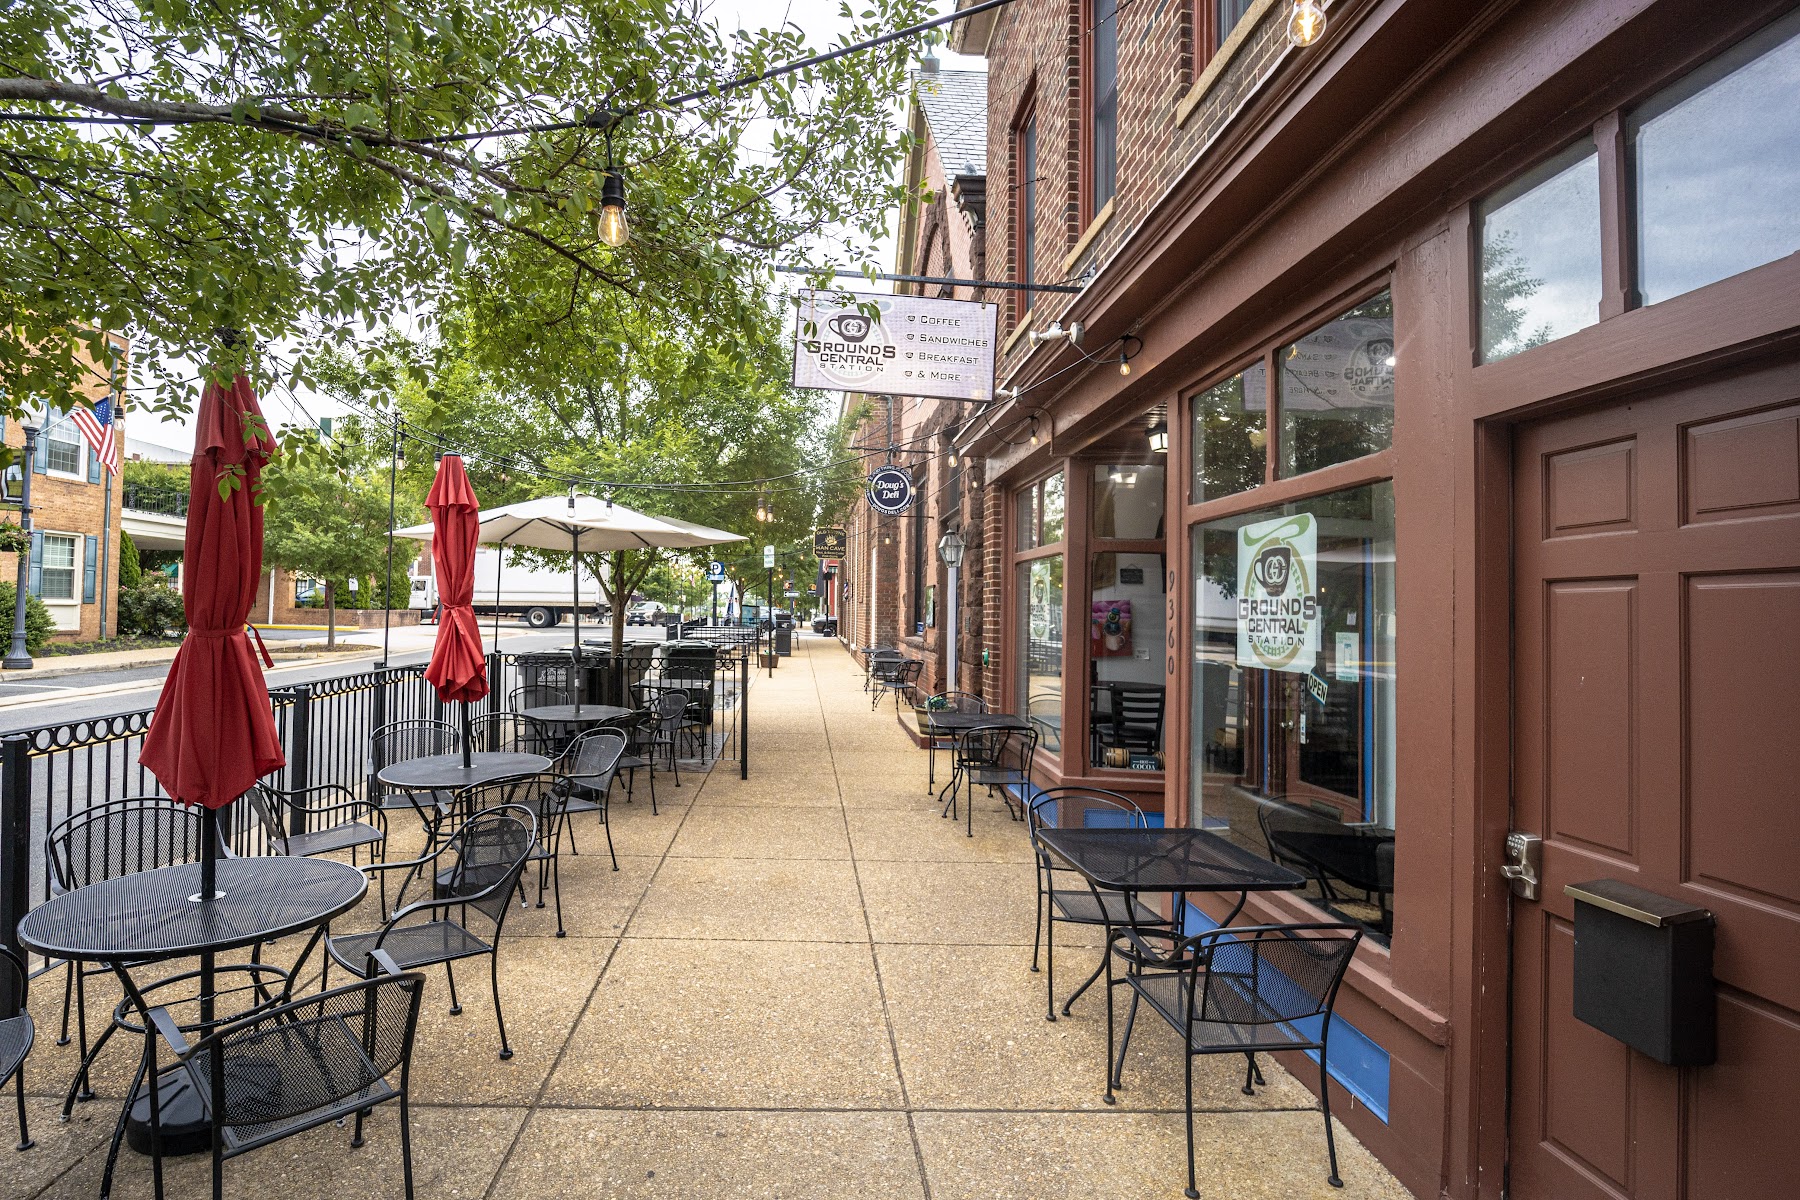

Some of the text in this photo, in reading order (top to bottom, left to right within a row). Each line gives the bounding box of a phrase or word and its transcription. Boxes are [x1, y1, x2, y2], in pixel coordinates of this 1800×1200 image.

[920, 315, 961, 327] COFFEE
[919, 334, 988, 347] SANDWICHES
[807, 341, 896, 359] GROUNDS
[820, 353, 884, 366] CENTRAL
[918, 352, 979, 364] BREAKFAST
[820, 364, 884, 372] STATION
[917, 370, 961, 381] & MORE
[877, 480, 904, 490] Doug's
[882, 490, 899, 499] Deli
[1238, 595, 1316, 620] GROUNDS
[1167, 570, 1175, 675] 9360
[1248, 618, 1304, 635] CENTRAL
[1248, 635, 1305, 646] STATION
[1308, 675, 1327, 701] OPEN
